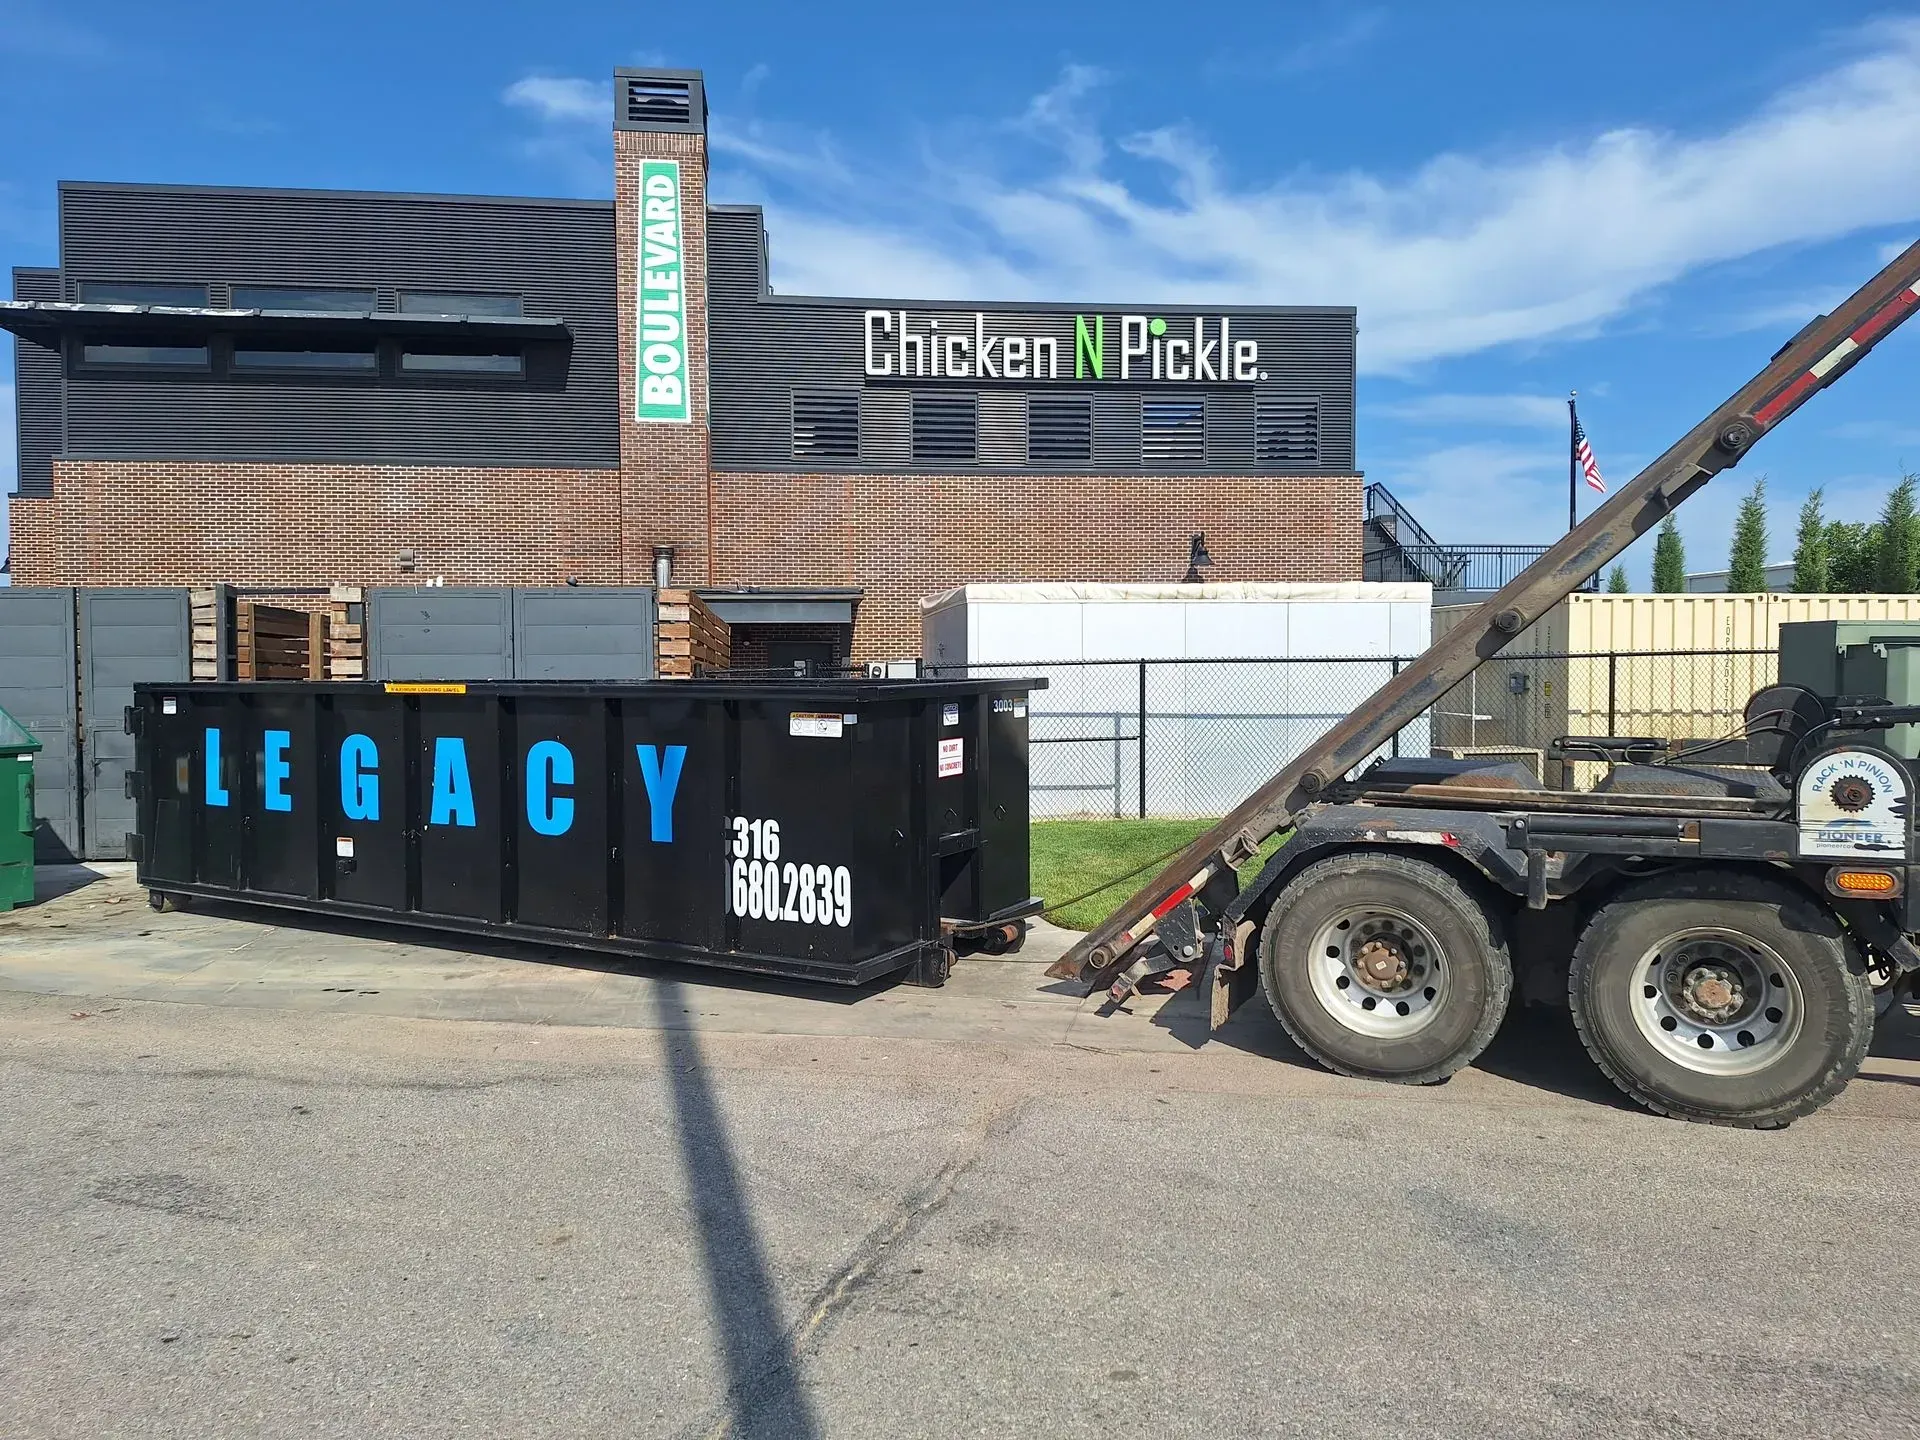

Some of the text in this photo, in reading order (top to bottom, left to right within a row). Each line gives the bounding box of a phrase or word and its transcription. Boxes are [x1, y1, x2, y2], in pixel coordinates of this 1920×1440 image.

[642, 174, 682, 406] BOULEVARD
[865, 310, 1057, 378] Chicken
[1075, 314, 1103, 379] N
[993, 699, 1013, 712] 3003
[942, 743, 958, 753] NO DIRT
[205, 728, 688, 843] LEGACY
[1812, 763, 1838, 792] RACK
[1857, 760, 1893, 793] PINION
[732, 816, 780, 862] 316
[1818, 831, 1883, 843] PIONEER
[732, 858, 852, 928] 680.2839
